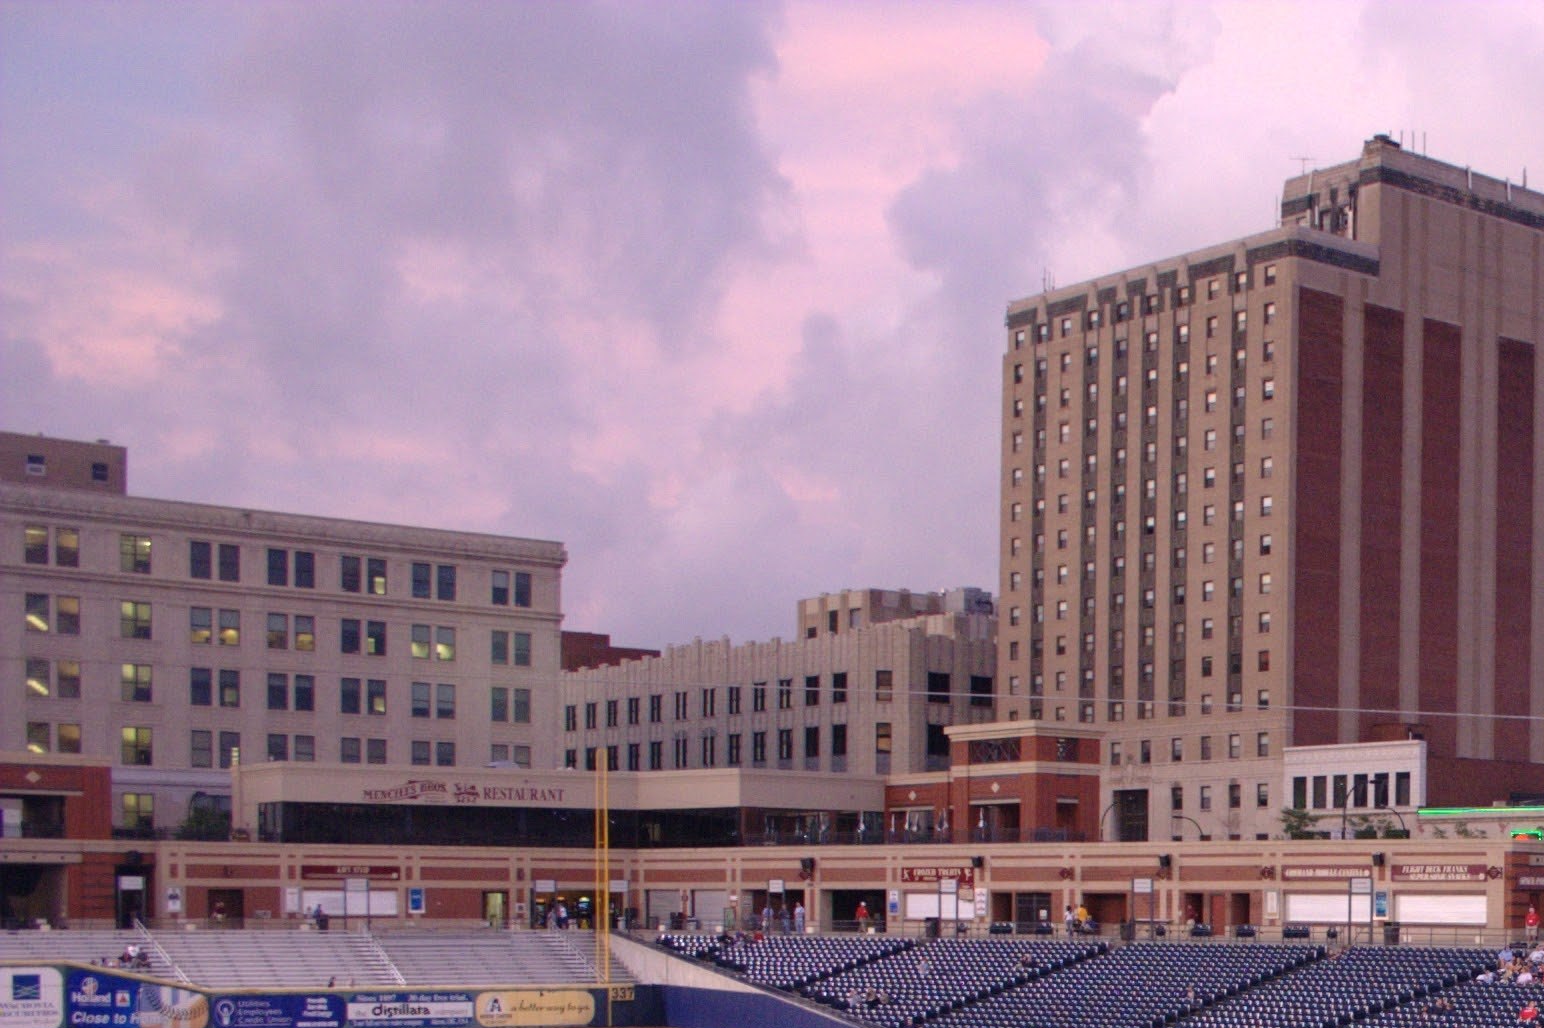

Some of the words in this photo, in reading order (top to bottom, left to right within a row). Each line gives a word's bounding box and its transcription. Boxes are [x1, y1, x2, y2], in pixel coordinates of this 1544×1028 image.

[483, 787, 564, 801] RESTAURANT
[1402, 865, 1425, 873] FLIGHT
[72, 992, 112, 1004] Holland
[611, 987, 633, 999] 337
[371, 1003, 431, 1017] distillata
[519, 1000, 543, 1012] better
[546, 1006, 565, 1014] way
[71, 1011, 110, 1024] Close
[113, 1011, 128, 1024] to
